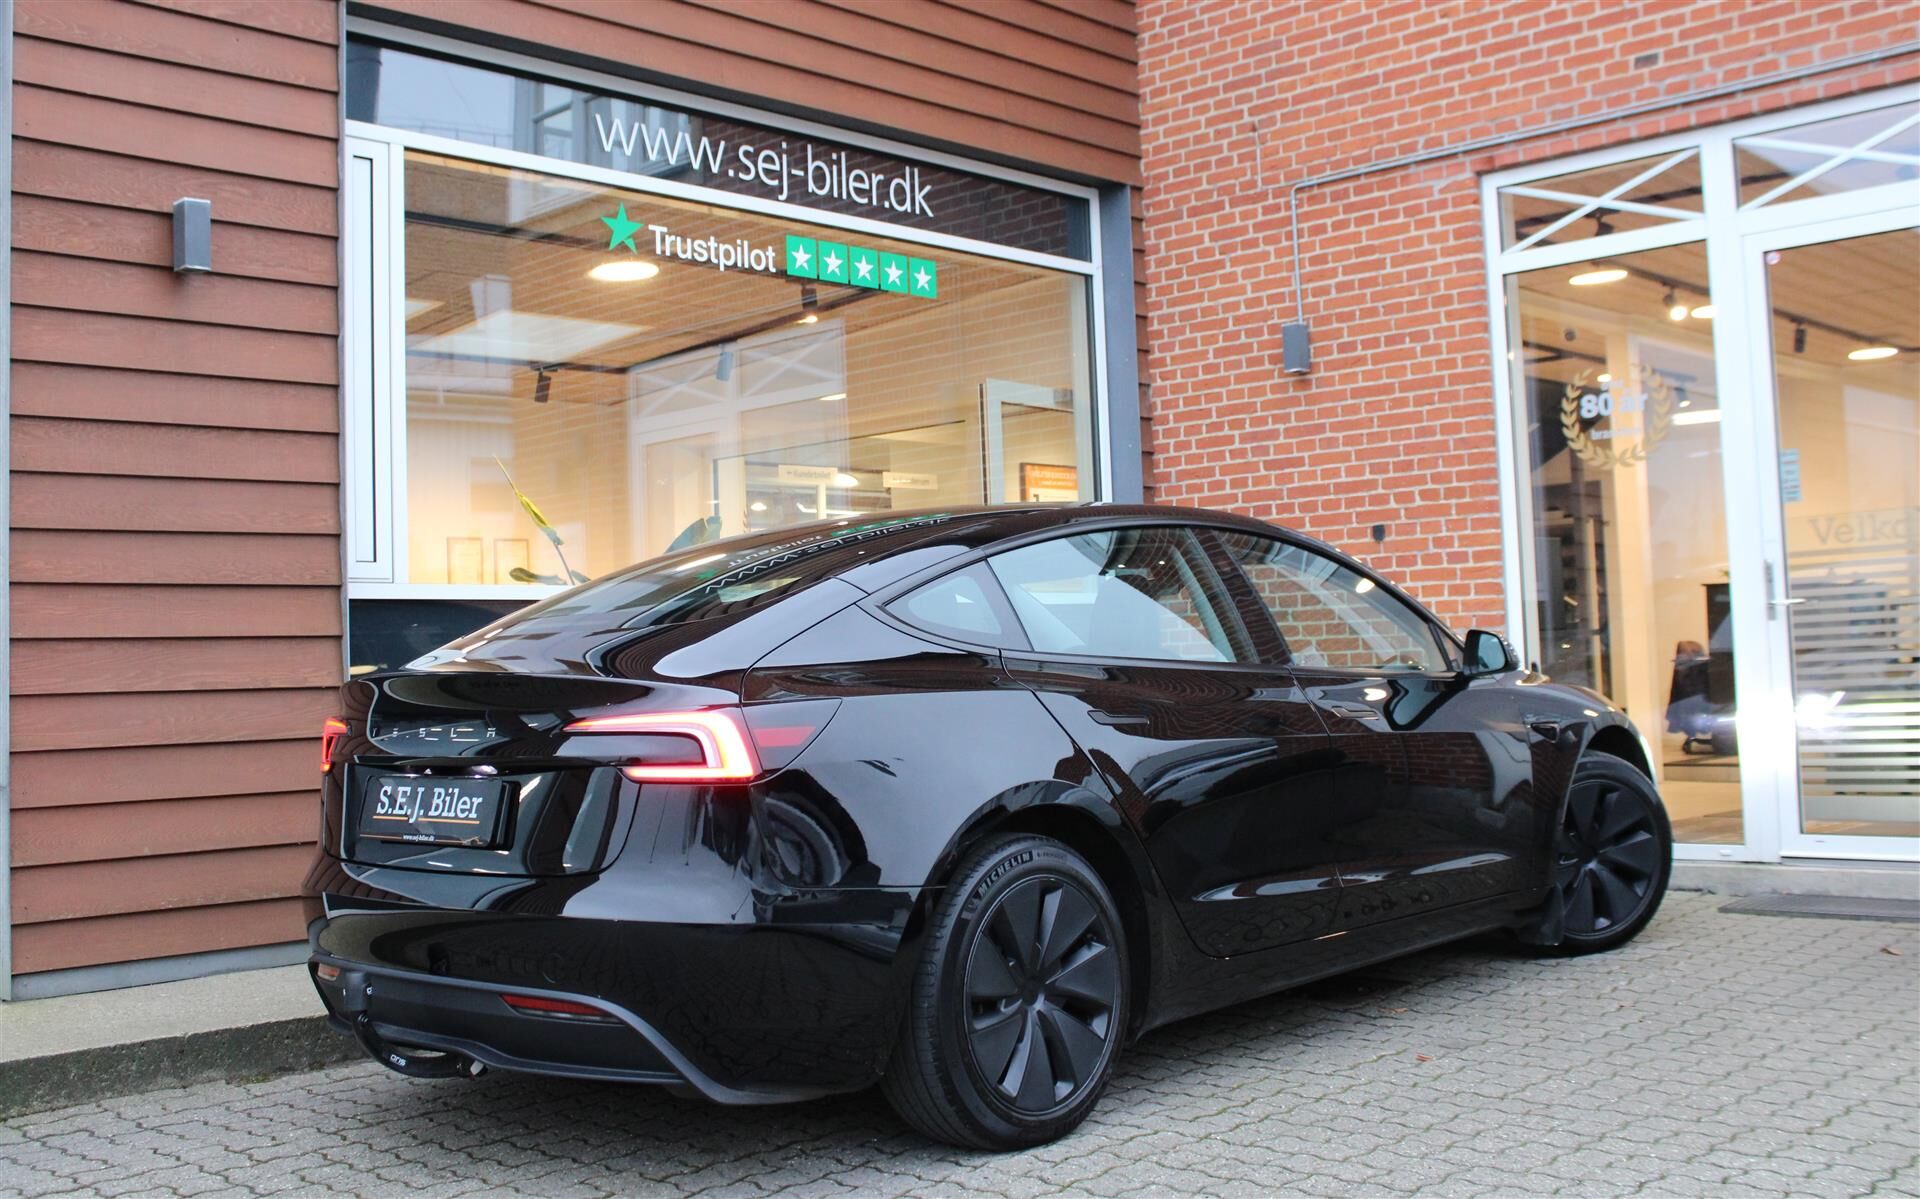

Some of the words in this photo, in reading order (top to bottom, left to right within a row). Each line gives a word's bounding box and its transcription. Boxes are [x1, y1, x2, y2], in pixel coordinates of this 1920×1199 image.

[595, 113, 934, 218] www.sej-biler.dk
[648, 224, 777, 274] Trustpilot
[1580, 393, 1614, 419] 80
[376, 785, 424, 823] S.E.J.
[428, 787, 483, 819] Biler
[978, 852, 1031, 898] MICHELIN
